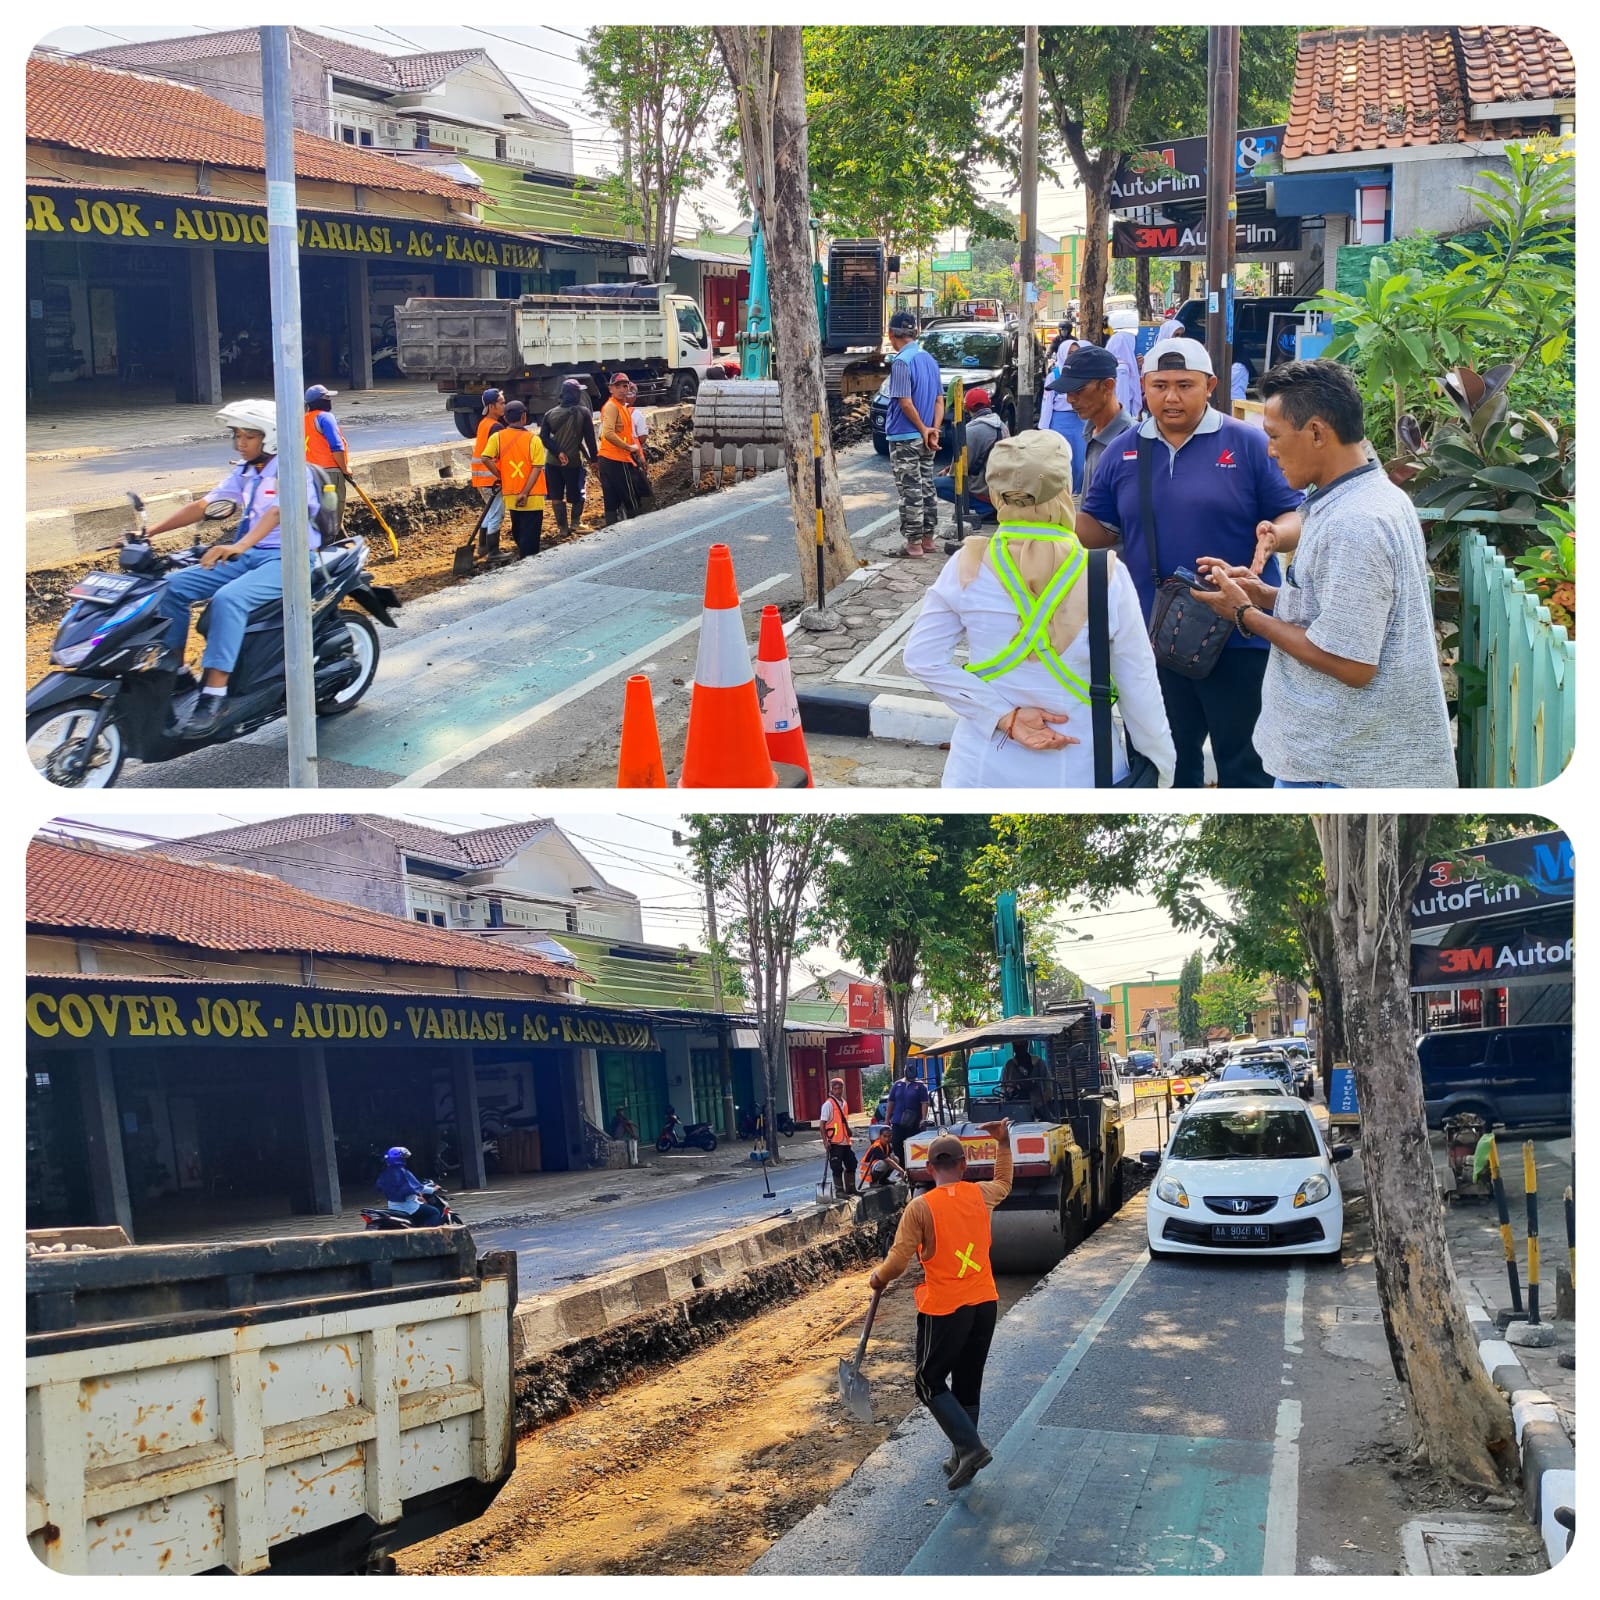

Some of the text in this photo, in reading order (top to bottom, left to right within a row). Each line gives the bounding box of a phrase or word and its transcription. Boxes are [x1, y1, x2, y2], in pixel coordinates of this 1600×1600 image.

[26, 194, 65, 232] R
[70, 198, 150, 237] JOK
[172, 207, 269, 244] AUDIO
[406, 230, 433, 257] AC
[445, 235, 498, 266] KACA
[501, 243, 544, 269] FILM
[1135, 227, 1178, 248] 3M
[1439, 946, 1494, 973] 3M
[26, 992, 187, 1038] COVER
[192, 996, 269, 1038] JOK
[291, 1001, 388, 1039] AUDIO
[405, 1006, 508, 1041] VARIASI
[522, 1013, 550, 1041] AC
[559, 1015, 616, 1045] KACA
